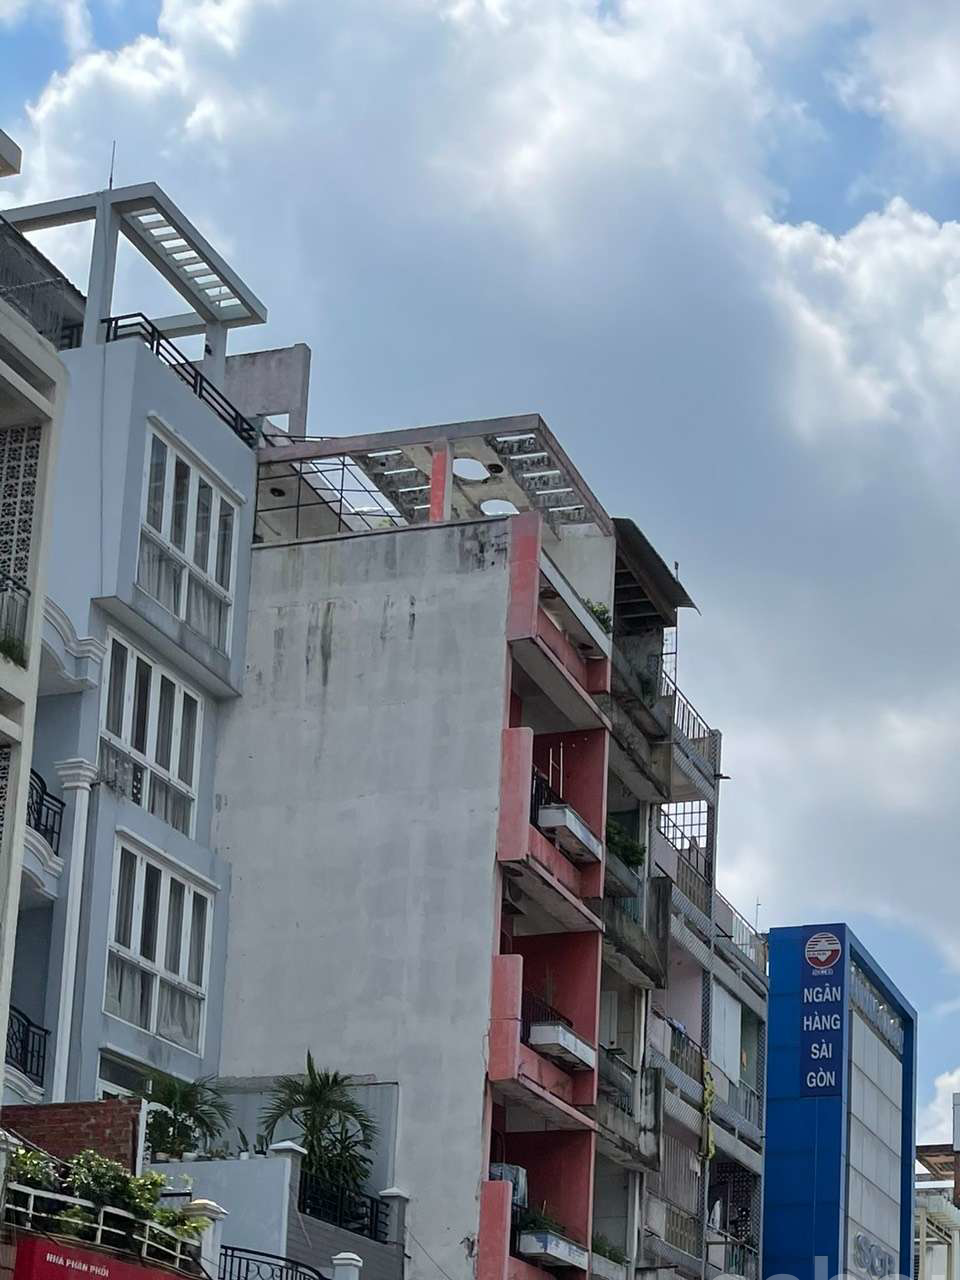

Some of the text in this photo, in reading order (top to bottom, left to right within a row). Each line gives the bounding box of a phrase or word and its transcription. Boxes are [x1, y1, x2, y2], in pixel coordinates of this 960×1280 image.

[804, 983, 841, 1003] NGÂN
[803, 1011, 841, 1031] HÀNG
[811, 1039, 832, 1059] SÀI
[807, 1067, 836, 1087] GÒN
